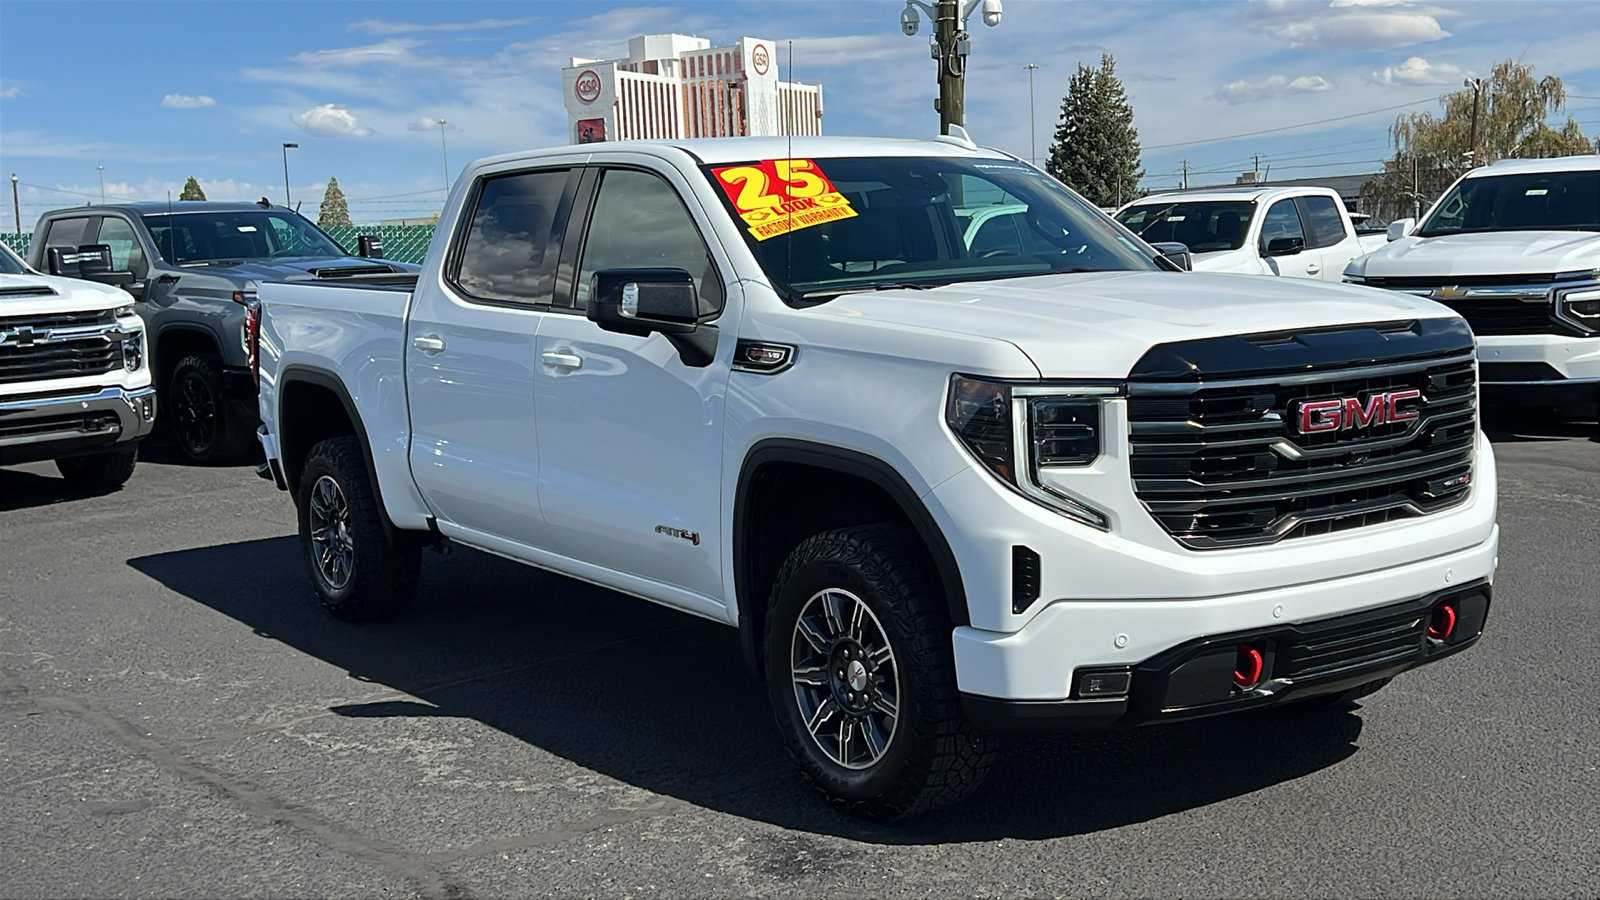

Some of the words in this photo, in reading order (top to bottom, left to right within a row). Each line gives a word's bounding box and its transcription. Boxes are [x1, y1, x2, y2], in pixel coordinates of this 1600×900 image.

[755, 53, 768, 66] GSR
[579, 79, 598, 94] GSR
[720, 160, 828, 210] 25
[770, 197, 819, 216] LOOK
[755, 216, 800, 237] FACTORY
[798, 206, 850, 225] WARRANTY
[1299, 390, 1420, 434] GMC
[655, 525, 700, 546] AT4
